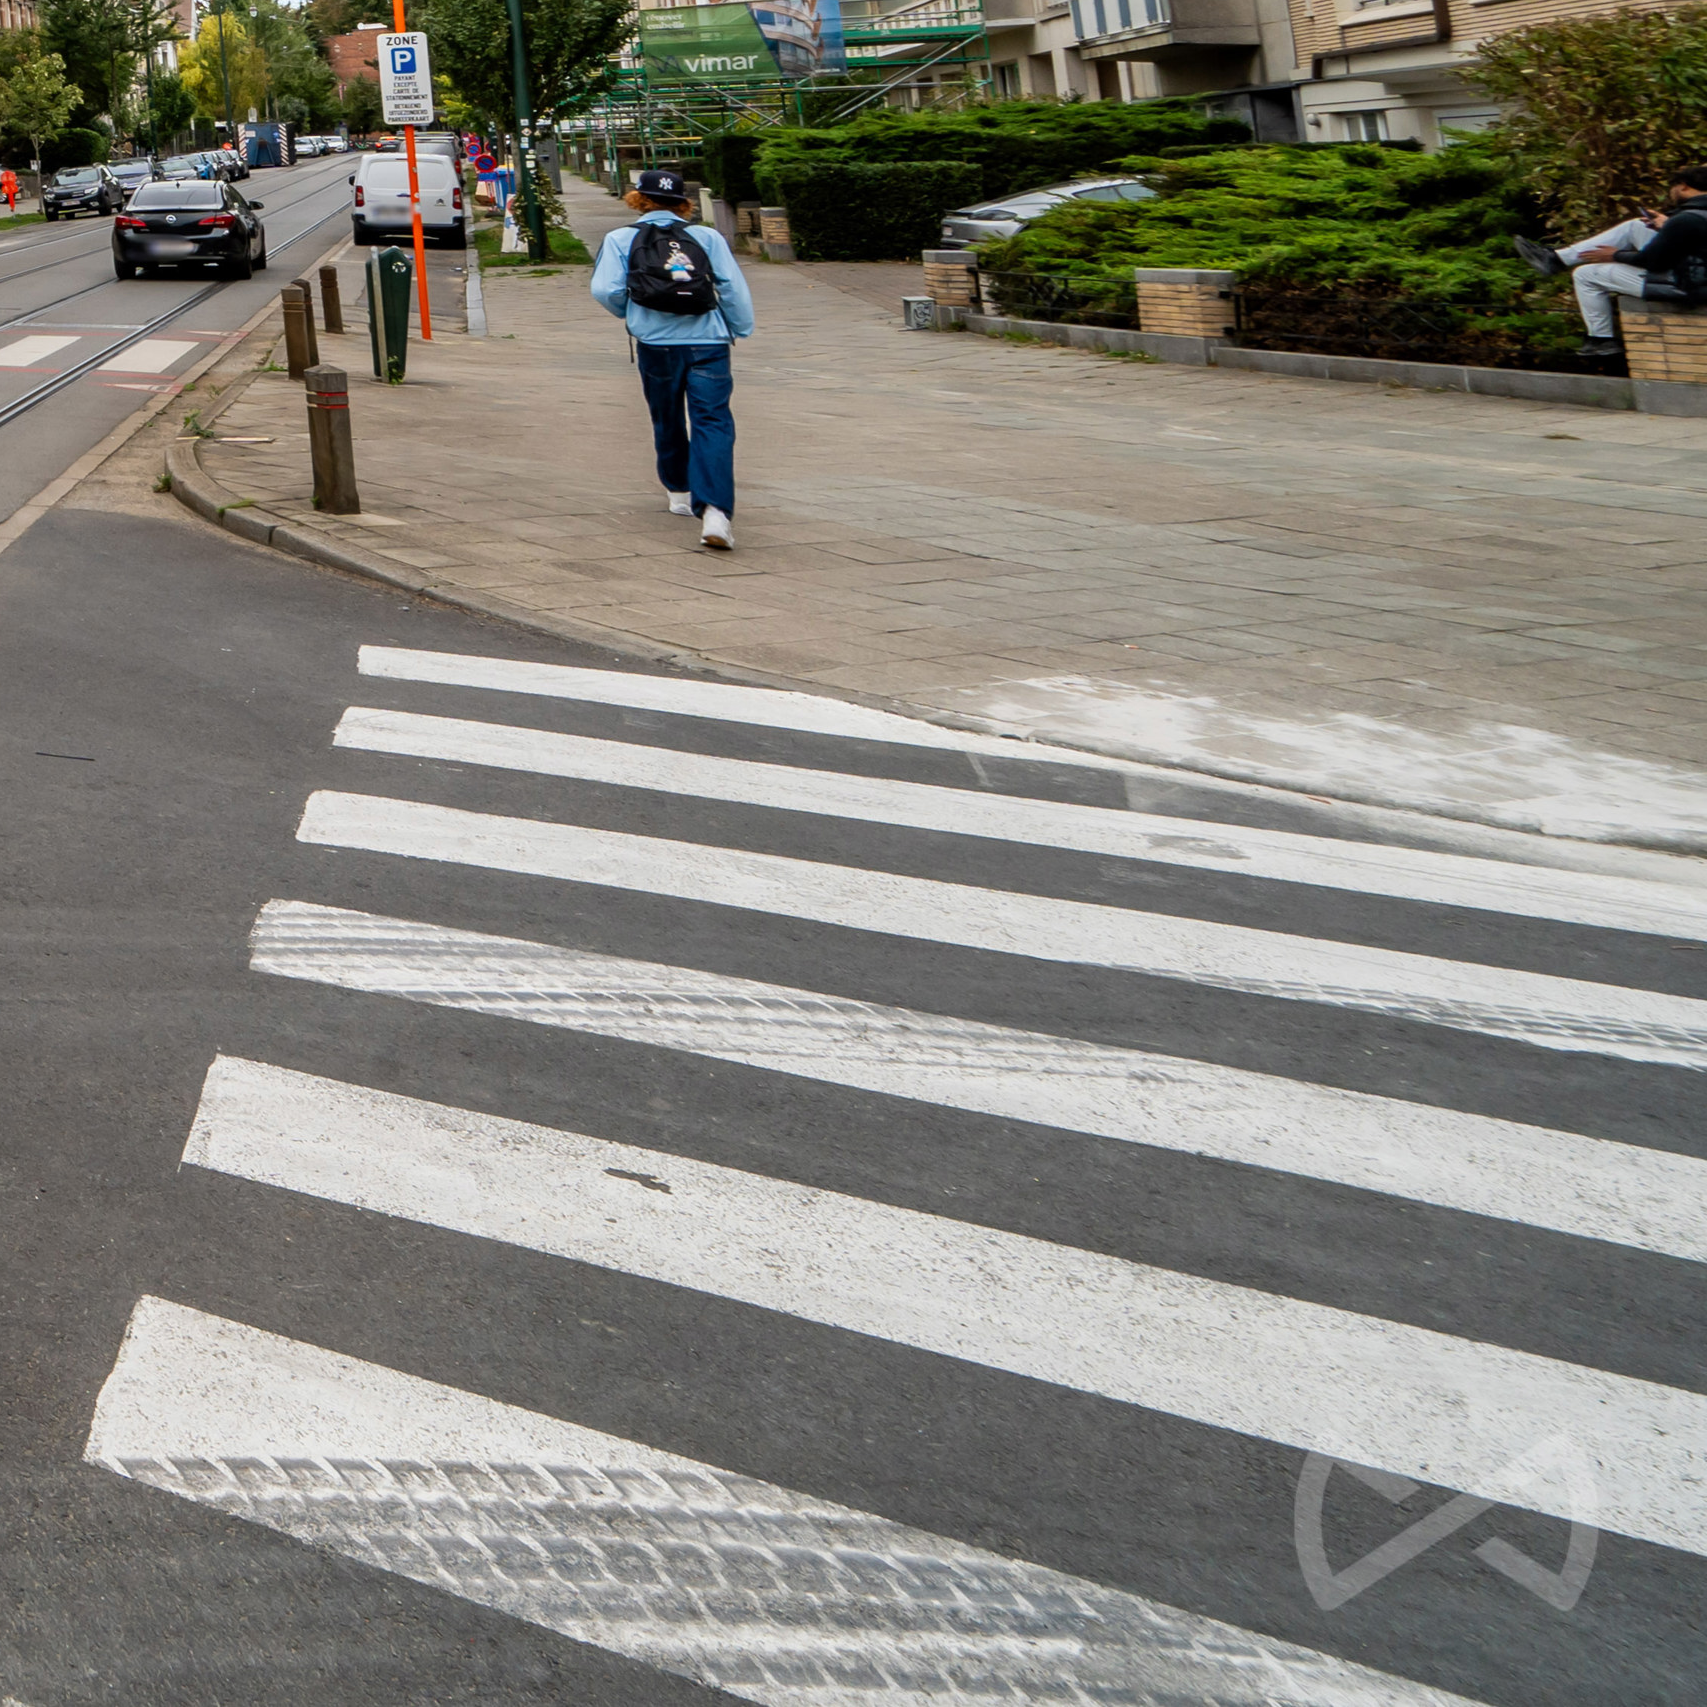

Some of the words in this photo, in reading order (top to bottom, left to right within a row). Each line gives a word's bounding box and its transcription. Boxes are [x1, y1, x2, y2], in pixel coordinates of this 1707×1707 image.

[386, 36, 418, 46] ZONE
[394, 50, 412, 72] P
[684, 54, 758, 72] vimar
